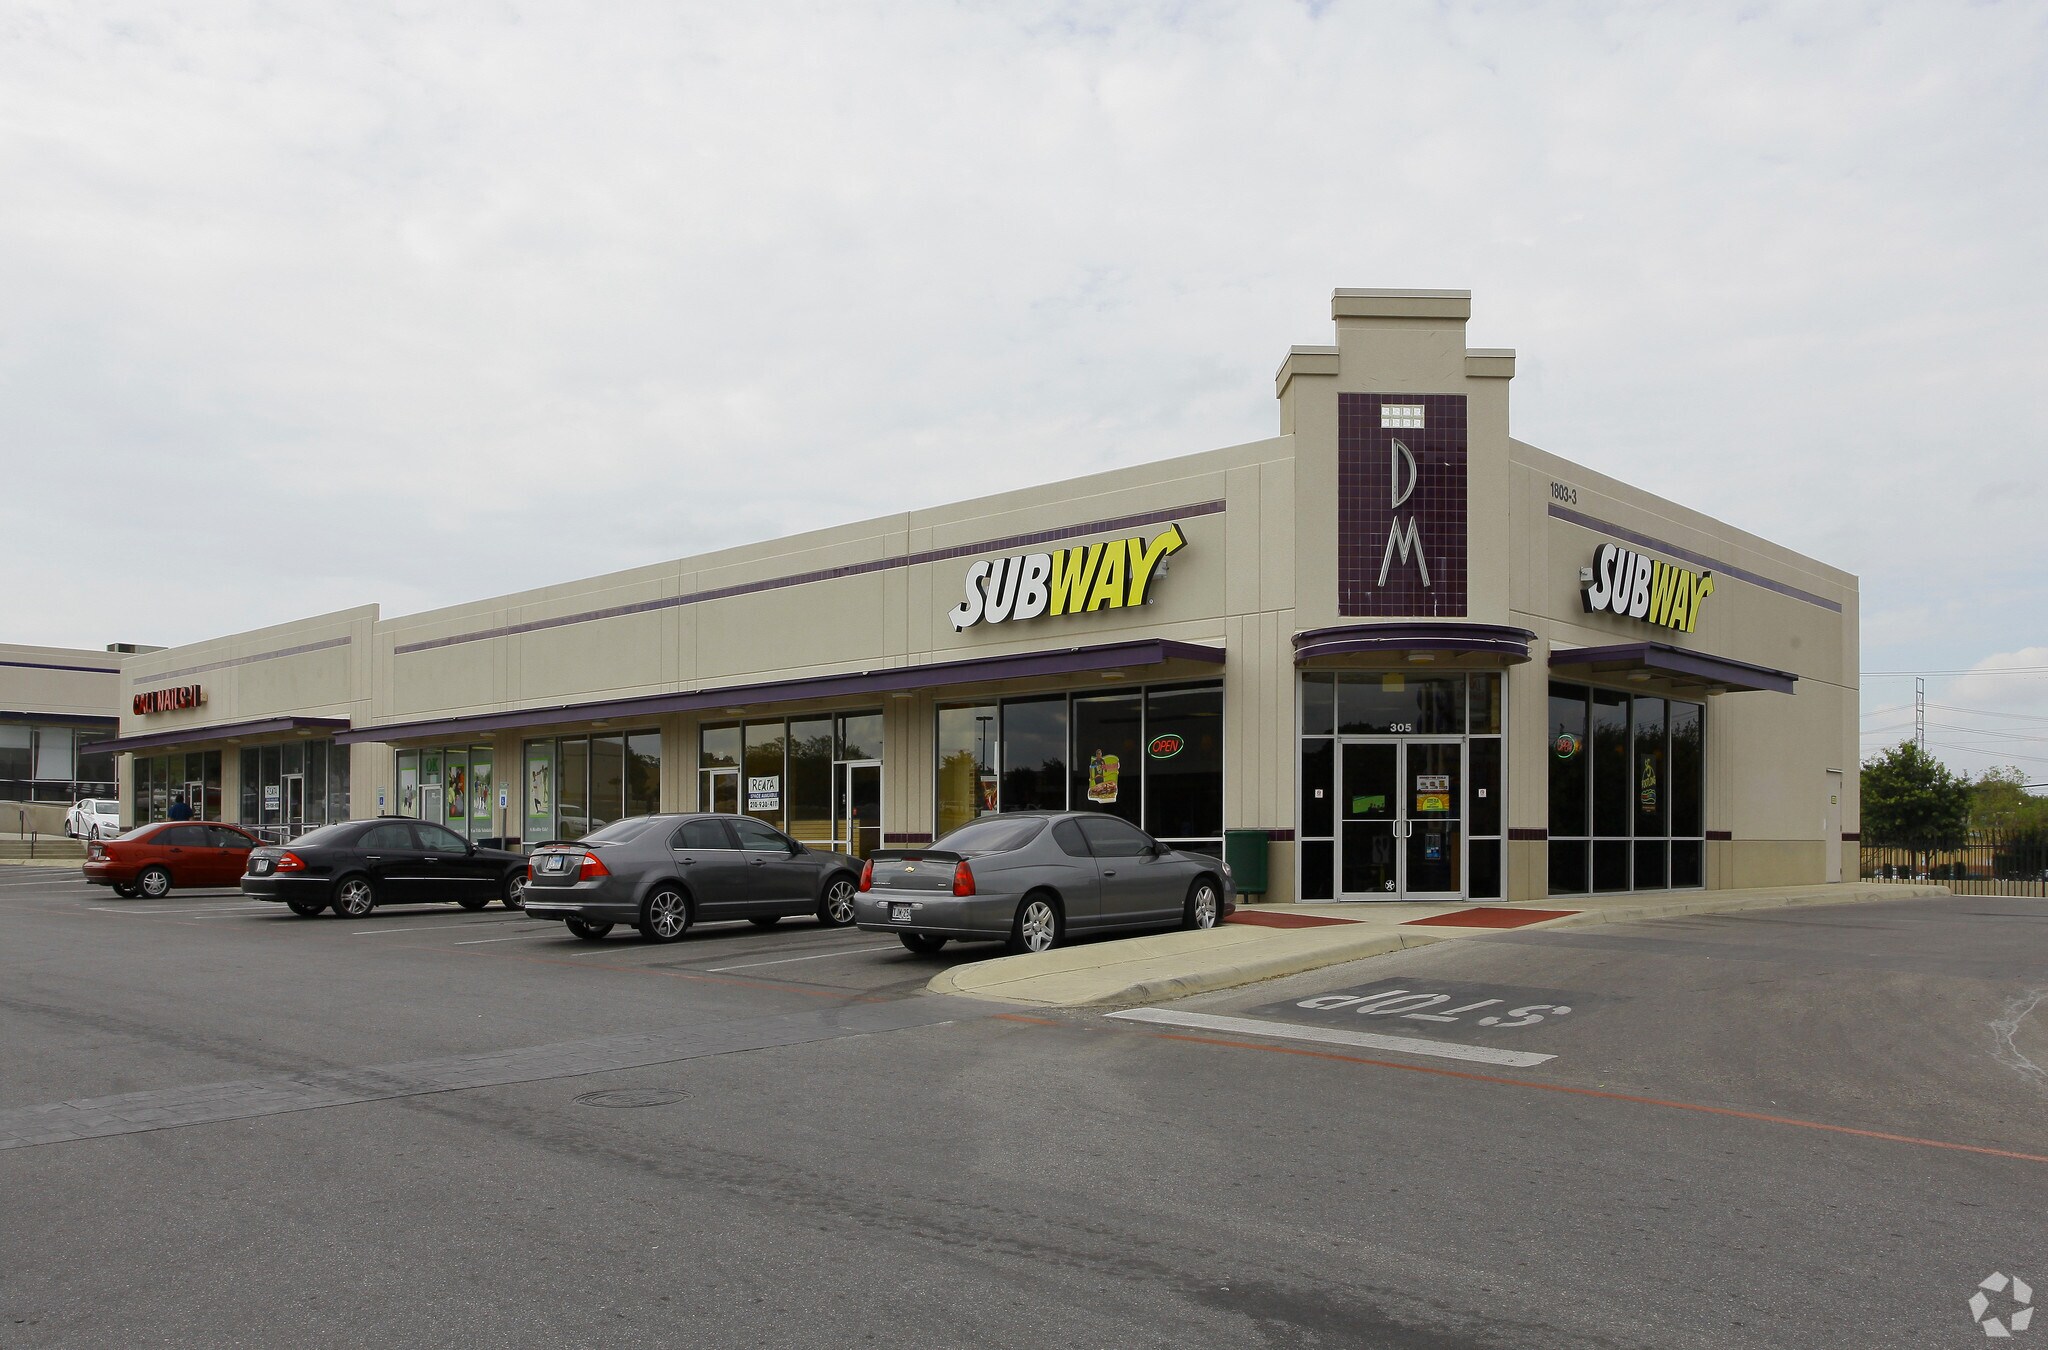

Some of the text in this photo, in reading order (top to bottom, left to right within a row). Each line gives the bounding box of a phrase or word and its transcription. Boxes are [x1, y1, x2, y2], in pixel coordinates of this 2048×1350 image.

[1392, 438, 1417, 509] D
[1550, 482, 1577, 505] 1803-3
[1378, 516, 1430, 588] M
[948, 523, 1188, 632] SUBWAY
[1581, 543, 1715, 633] SUBWAY
[1152, 739, 1179, 753] OPEN
[1390, 723, 1412, 732] 305
[752, 779, 774, 790] REATA
[1296, 990, 1572, 1027] STOP
